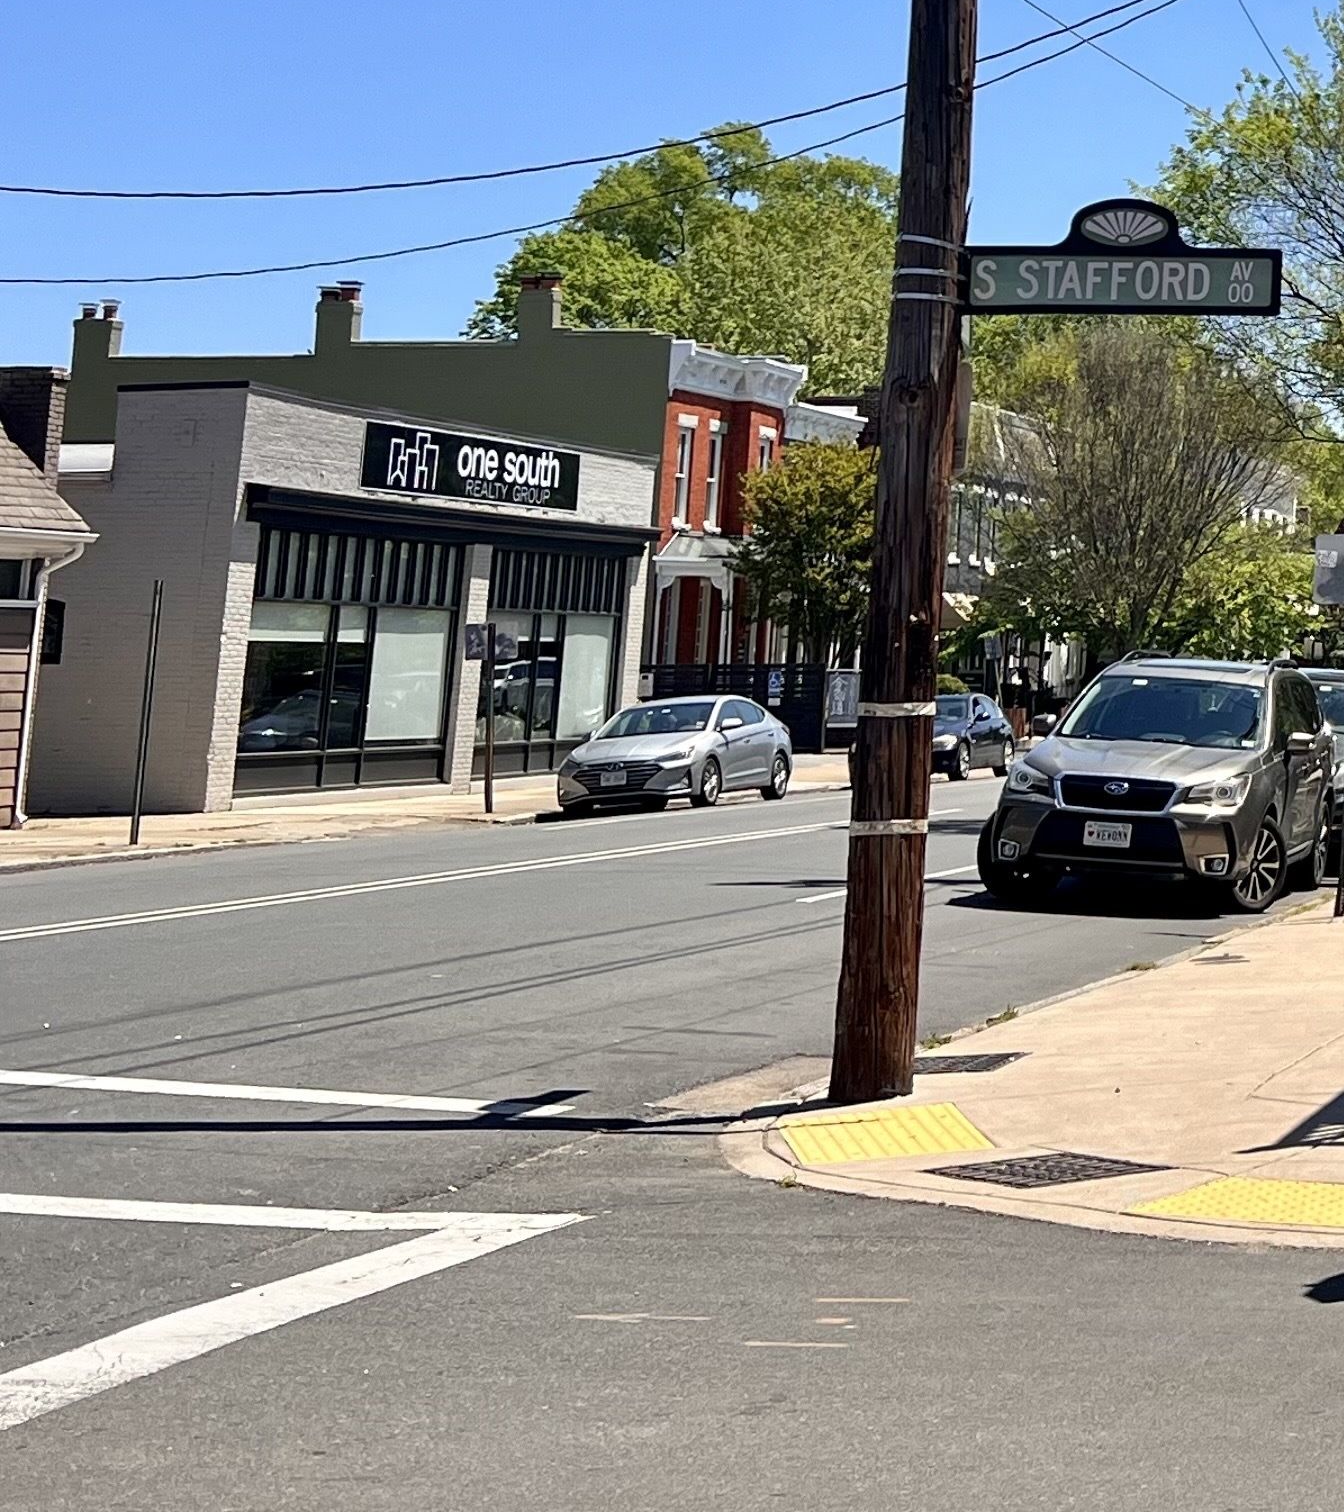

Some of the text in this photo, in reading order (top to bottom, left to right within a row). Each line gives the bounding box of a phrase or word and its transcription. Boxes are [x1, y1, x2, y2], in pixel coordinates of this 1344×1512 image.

[972, 259, 1254, 302] S STAFFORD AV
[457, 445, 560, 488] one south
[465, 479, 551, 505] REALTY GROUP
